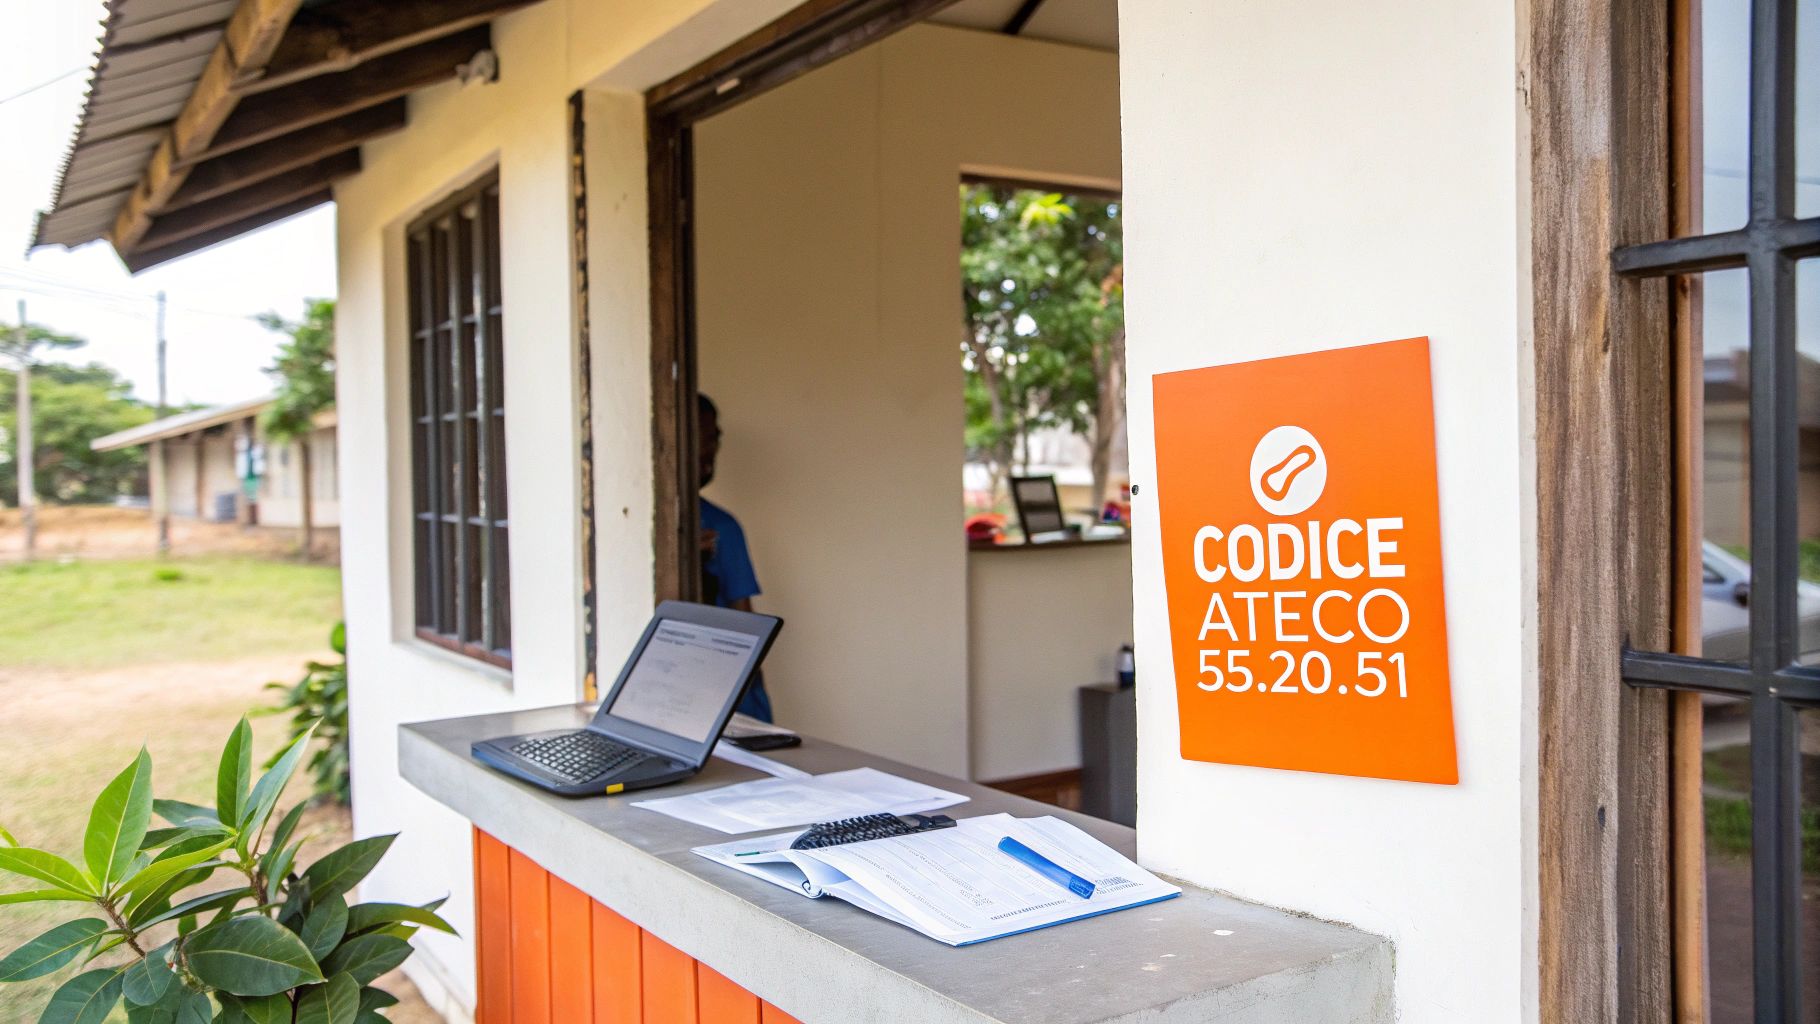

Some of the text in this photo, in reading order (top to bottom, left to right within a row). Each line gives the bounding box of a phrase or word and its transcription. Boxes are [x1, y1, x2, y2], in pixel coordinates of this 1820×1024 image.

[1194, 517, 1406, 583] CODICE
[1197, 588, 1410, 644] ATECO
[1197, 648, 1408, 698] 55.20.51
